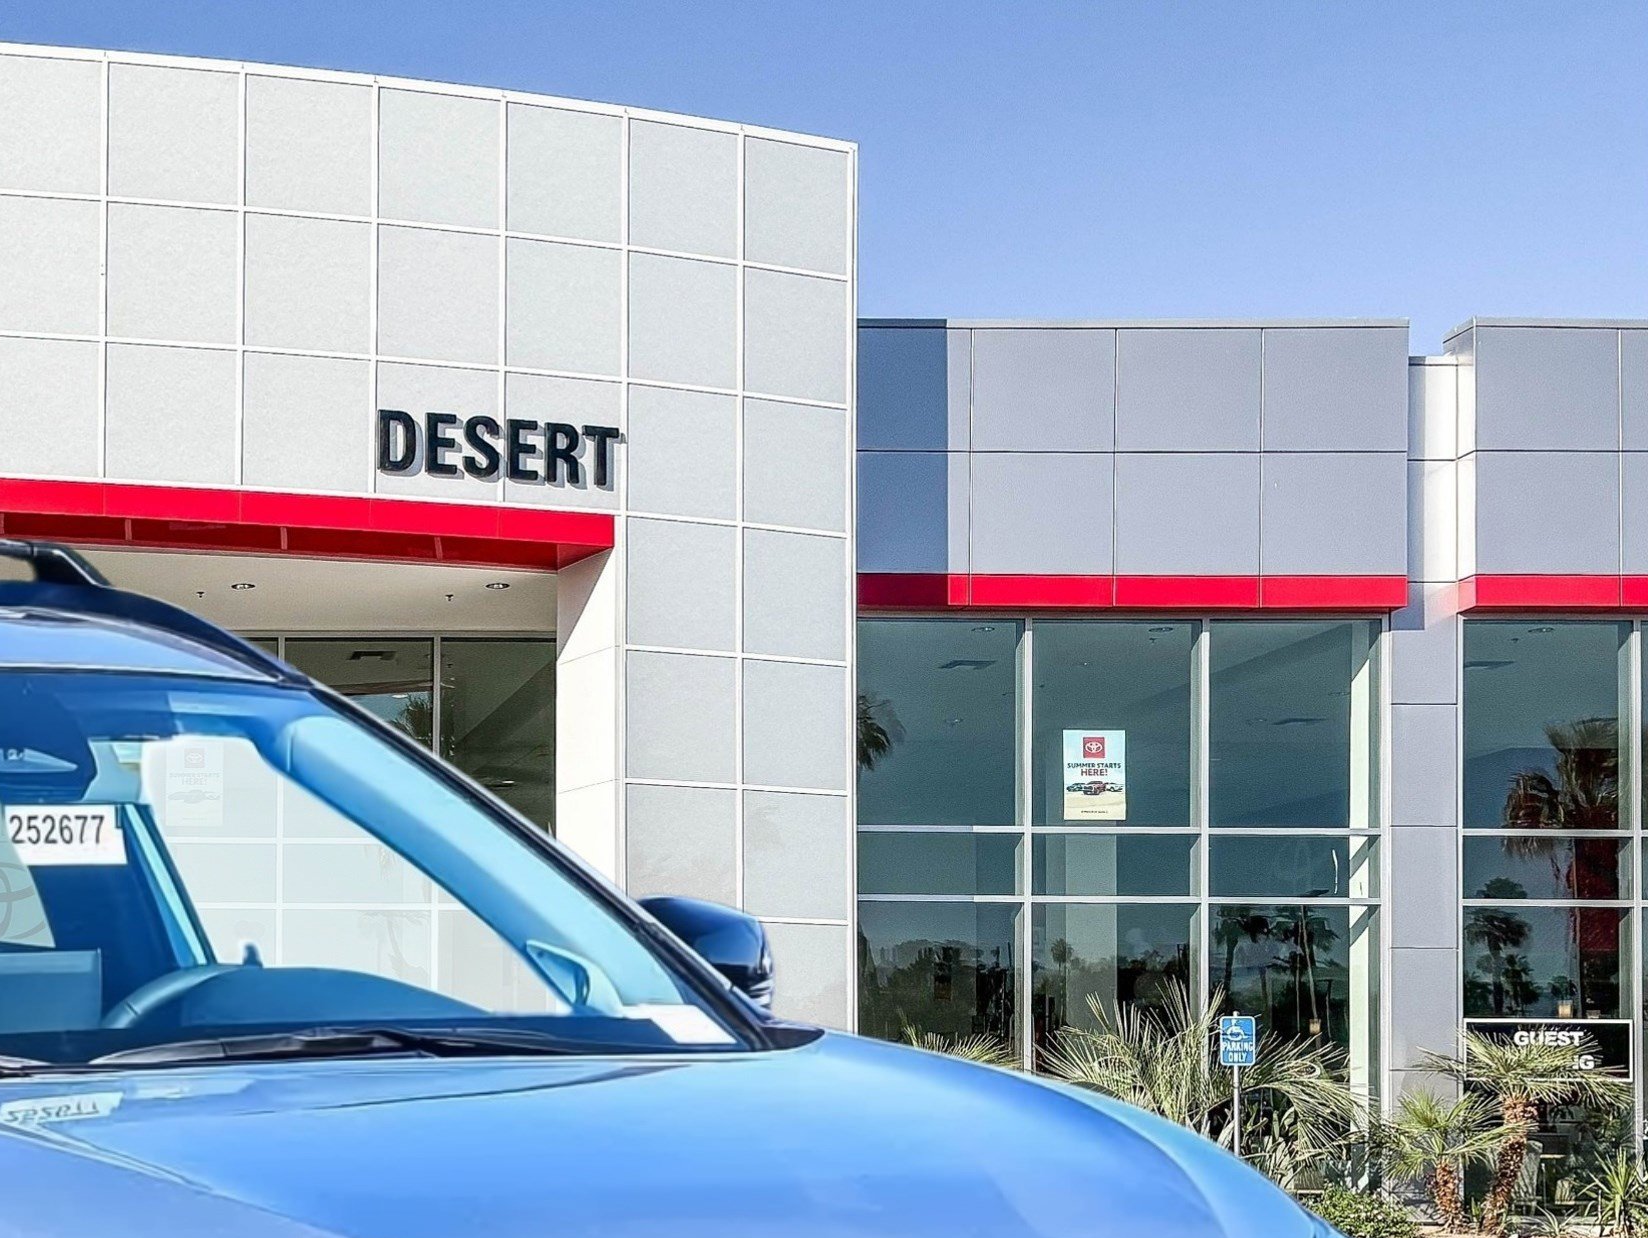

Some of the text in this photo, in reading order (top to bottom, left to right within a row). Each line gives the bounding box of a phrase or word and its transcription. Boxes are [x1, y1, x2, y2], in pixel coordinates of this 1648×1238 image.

[377, 409, 620, 486] DESERT
[1080, 768, 1108, 776] HERE!
[9, 814, 105, 845] 252677
[1513, 1031, 1584, 1047] GUEST
[1222, 1042, 1253, 1052] PARKING
[1228, 1052, 1247, 1062] ONLY
